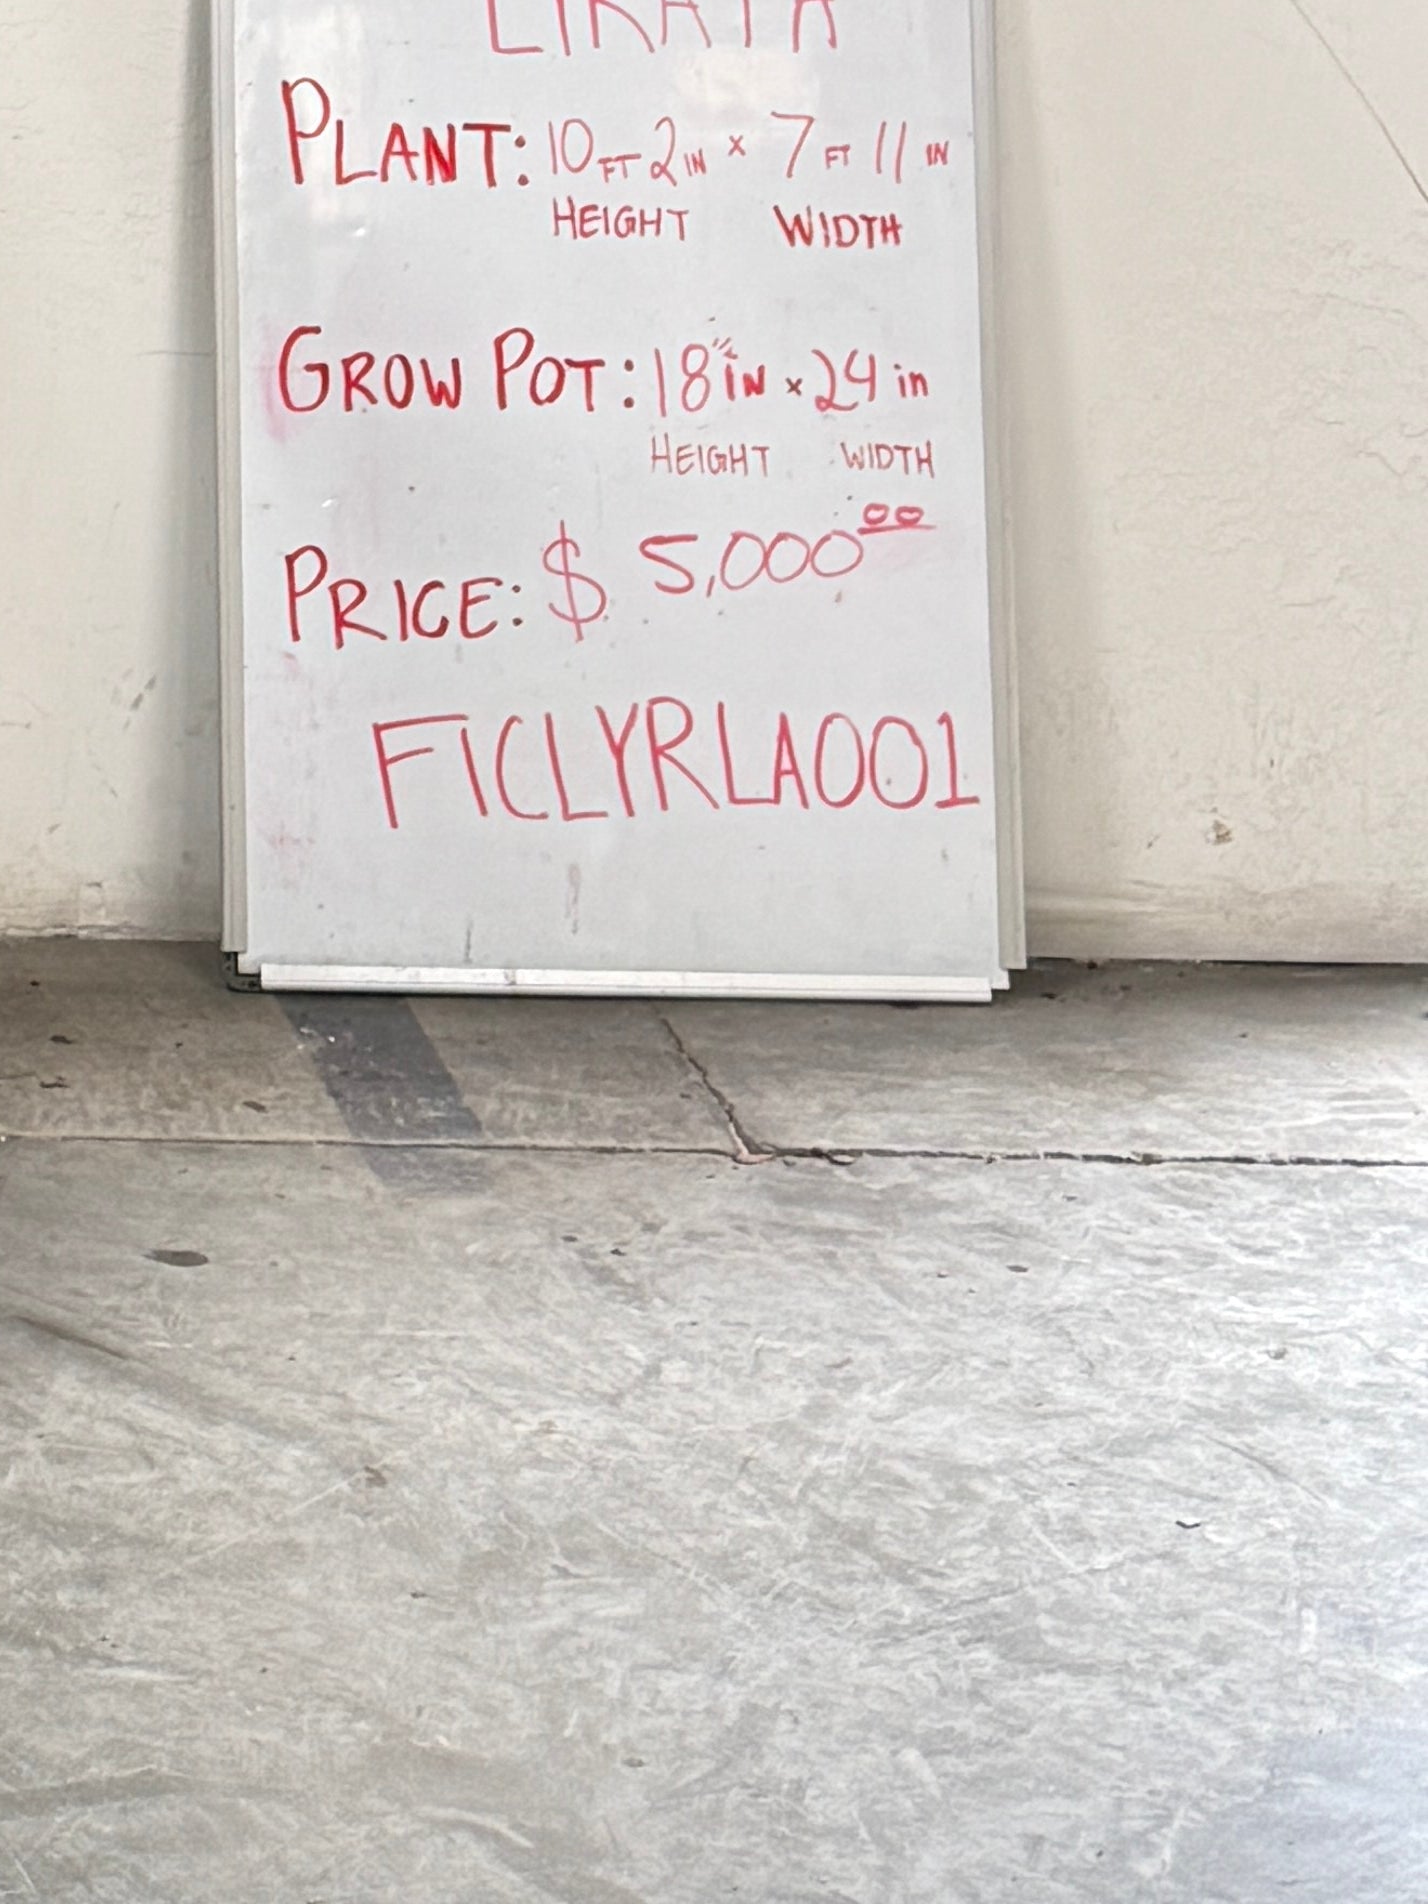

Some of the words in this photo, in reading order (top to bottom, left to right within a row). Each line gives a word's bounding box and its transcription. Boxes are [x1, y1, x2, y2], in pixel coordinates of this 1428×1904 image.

[281, 77, 531, 188] PLANT:
[771, 110, 815, 179] 7
[824, 143, 851, 170] FT
[875, 120, 907, 185] 11
[926, 140, 950, 167] IN
[552, 195, 690, 241] HEIGHT
[772, 205, 903, 249] WIDTH
[278, 325, 463, 413] GROW
[493, 327, 635, 412] POT:
[811, 348, 876, 412] 24
[651, 432, 771, 478] HEIGHT
[840, 440, 935, 479] WIDTH
[285, 545, 523, 650] PRICE:
[372, 695, 981, 829] FICLYRLA001
